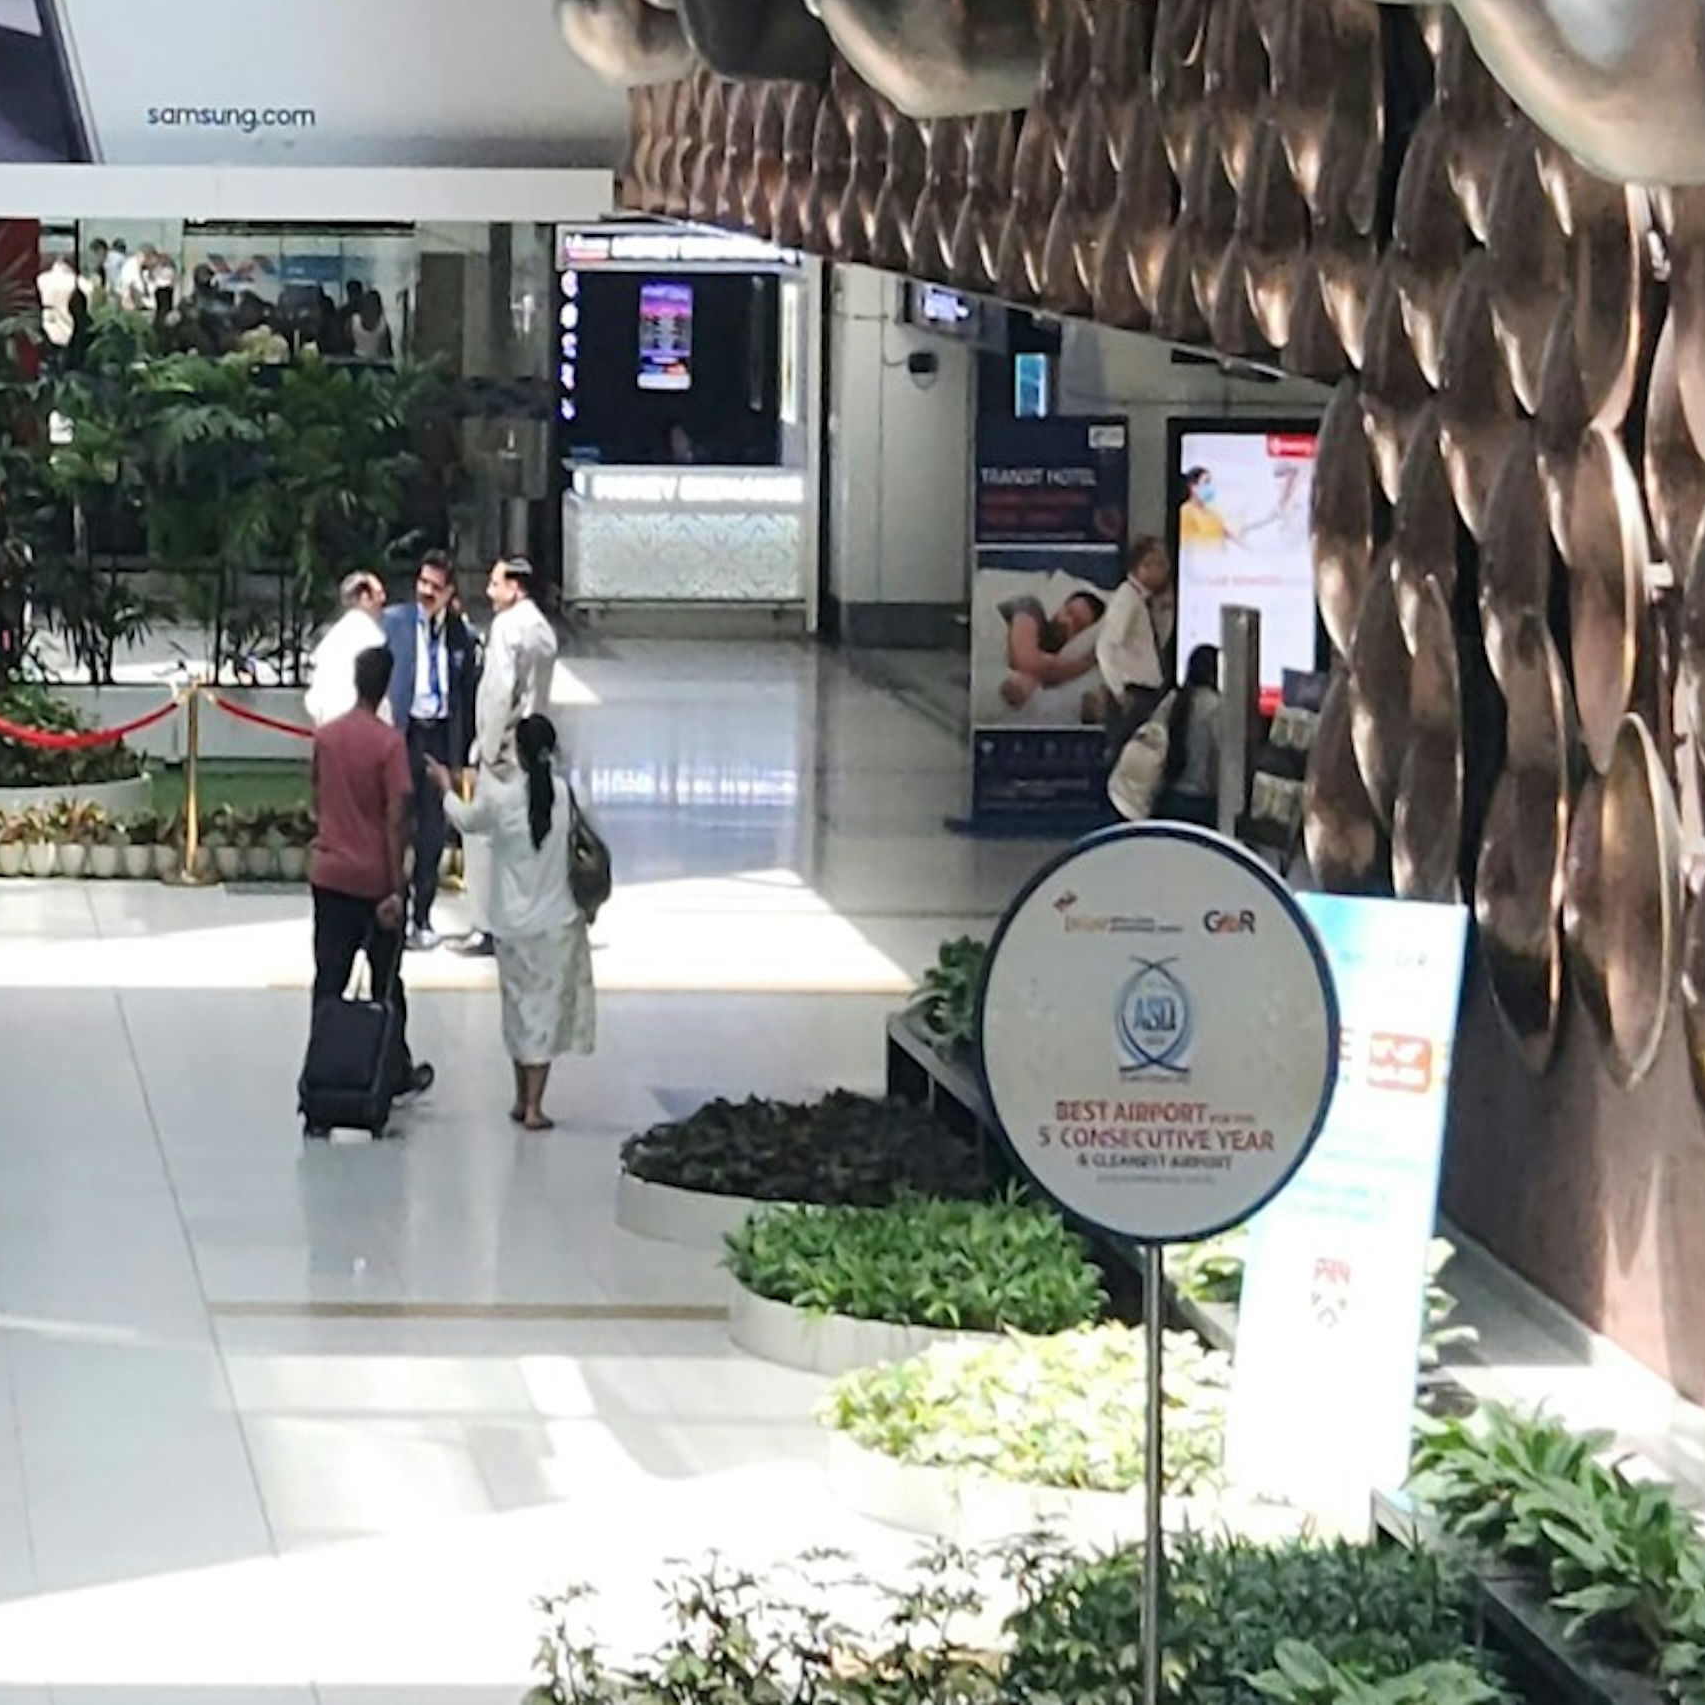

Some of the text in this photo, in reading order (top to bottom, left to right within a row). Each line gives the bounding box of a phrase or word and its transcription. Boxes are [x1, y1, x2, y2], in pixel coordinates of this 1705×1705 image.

[147, 107, 316, 133] samsung.com
[1055, 1101, 1108, 1122] BEST
[1114, 1102, 1209, 1123] AIRPORT
[1038, 1126, 1275, 1151] 5 CONSECUTIVE YEAR
[1170, 1155, 1232, 1170] AIRPORT
